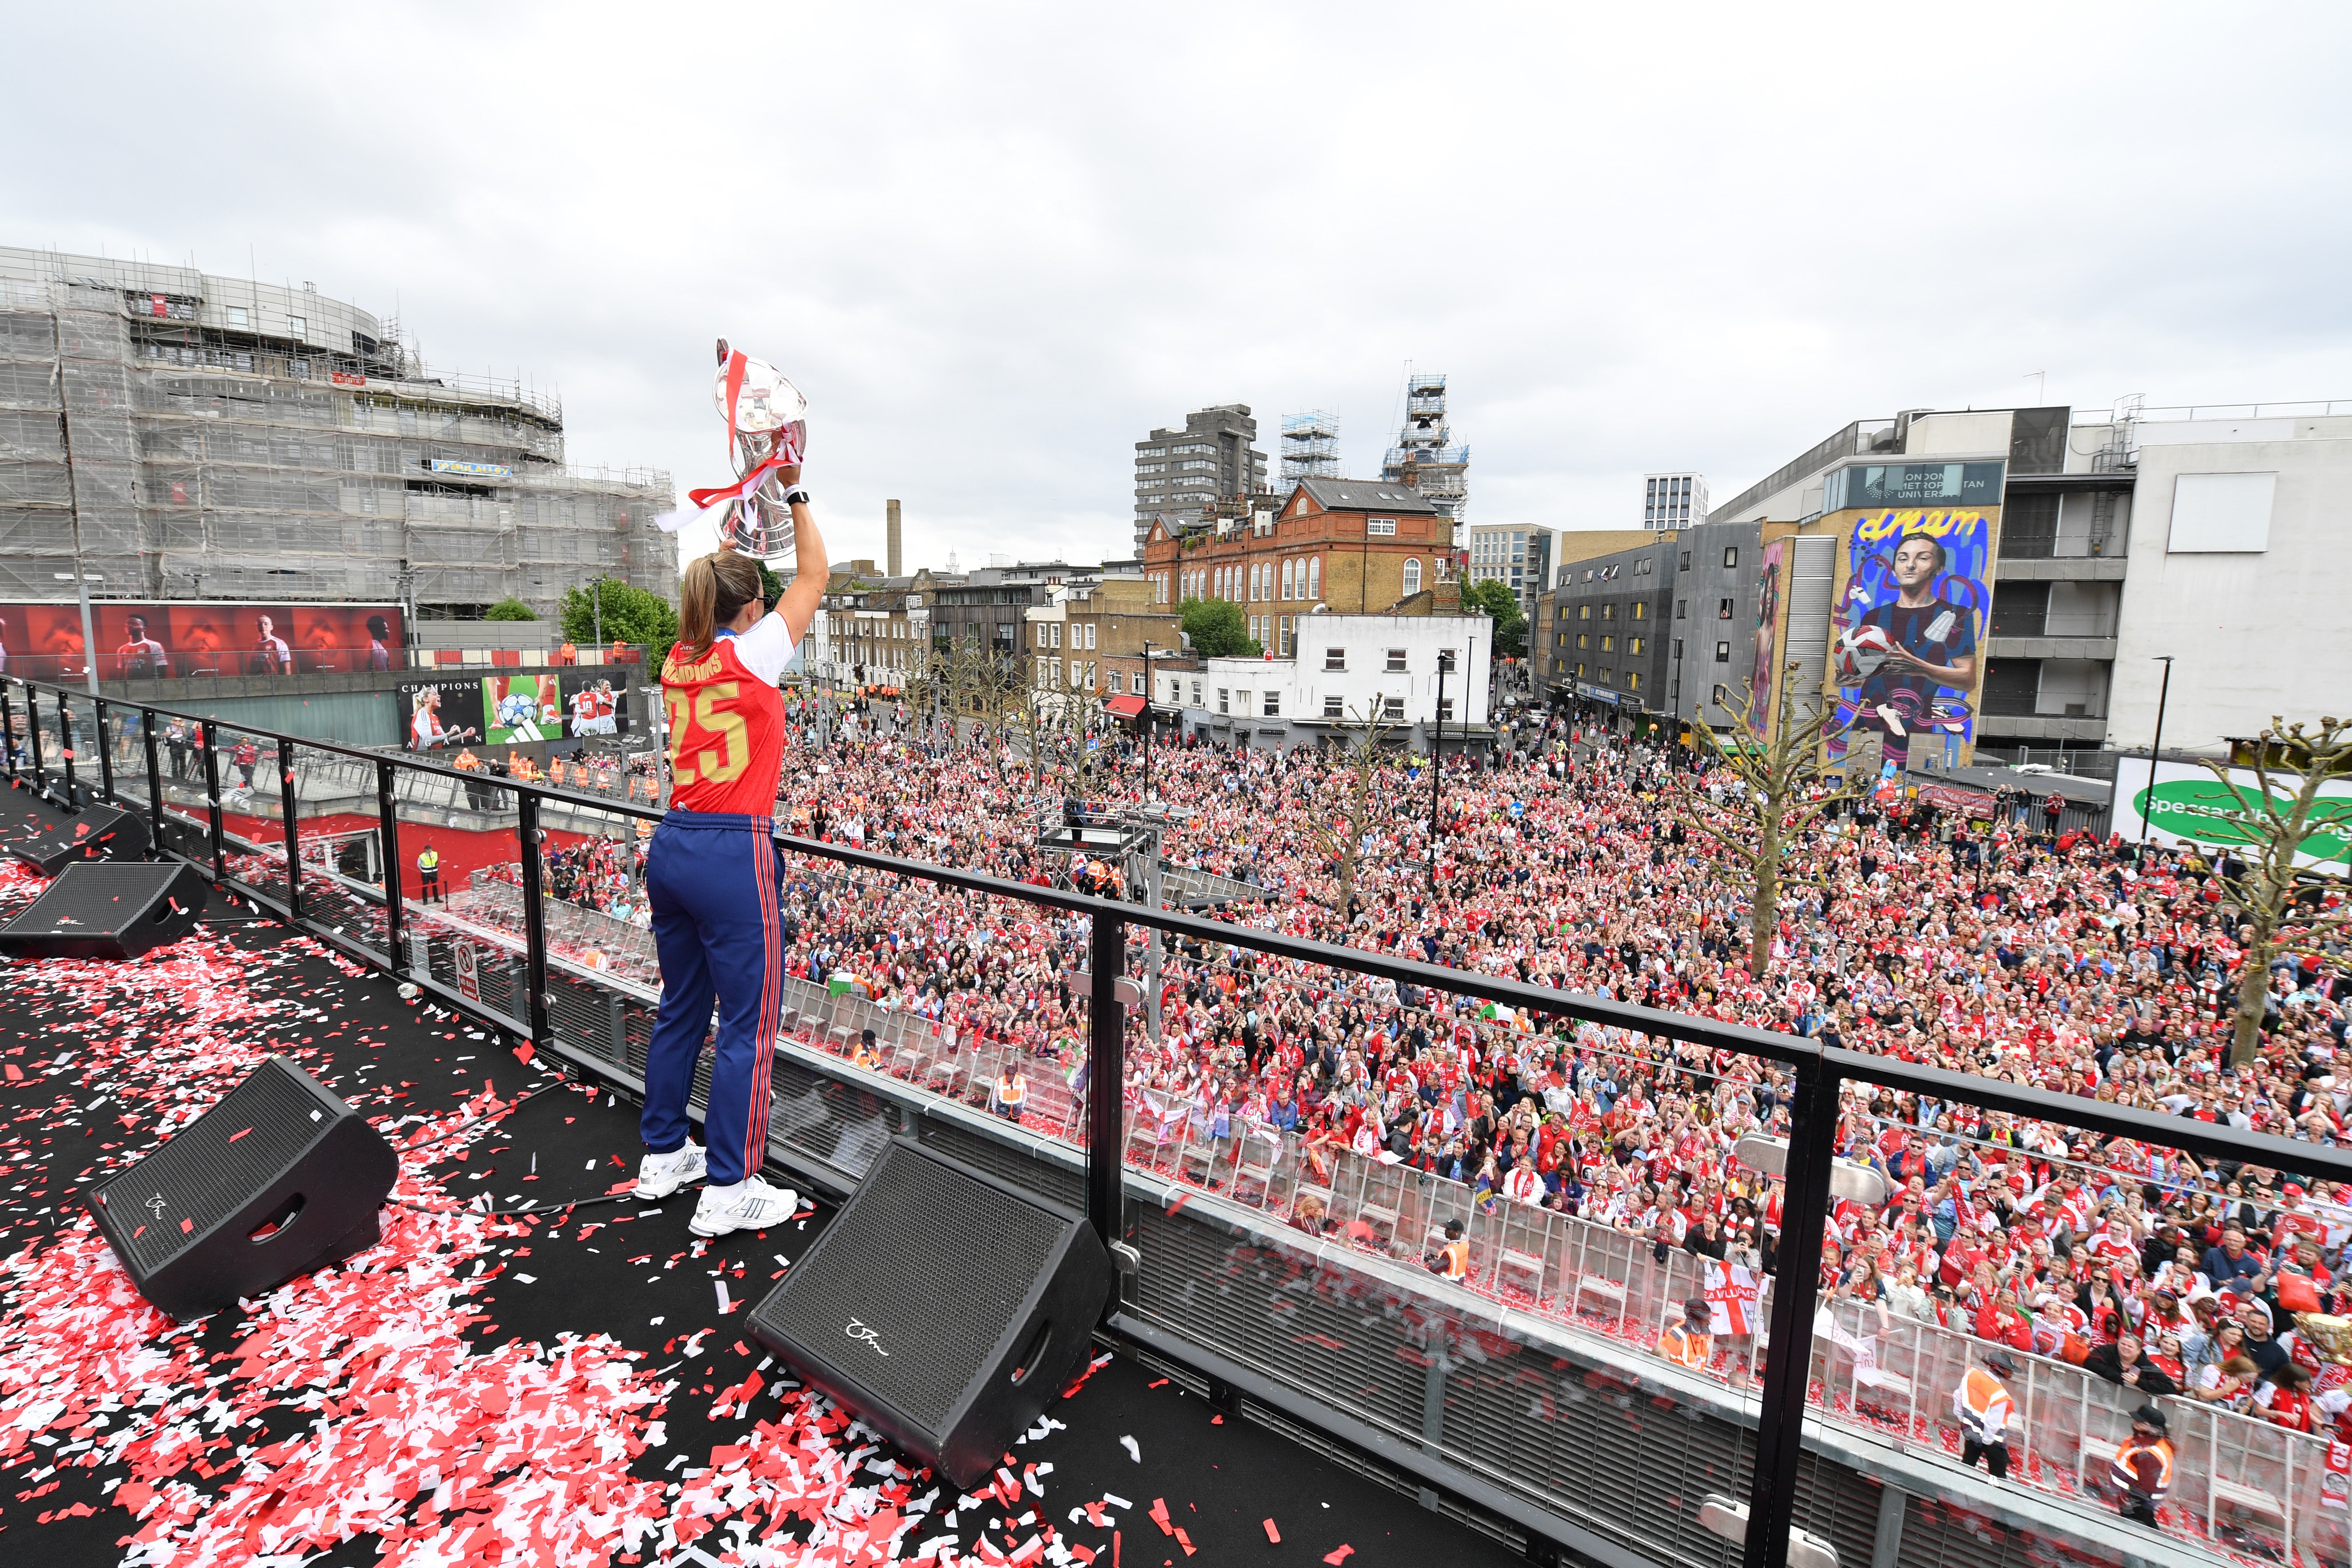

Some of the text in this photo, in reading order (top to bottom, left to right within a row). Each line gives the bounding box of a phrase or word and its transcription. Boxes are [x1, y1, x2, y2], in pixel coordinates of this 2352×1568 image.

[1903, 481, 1984, 489] ETROPTAN
[1858, 508, 1980, 541] dream
[402, 682, 478, 693] CHAMPIONS
[664, 680, 750, 785] 25
[406, 735, 482, 749] AGAIN
[460, 977, 476, 990] NO BALL
[1716, 1287, 1756, 1299] WLLIAMS
